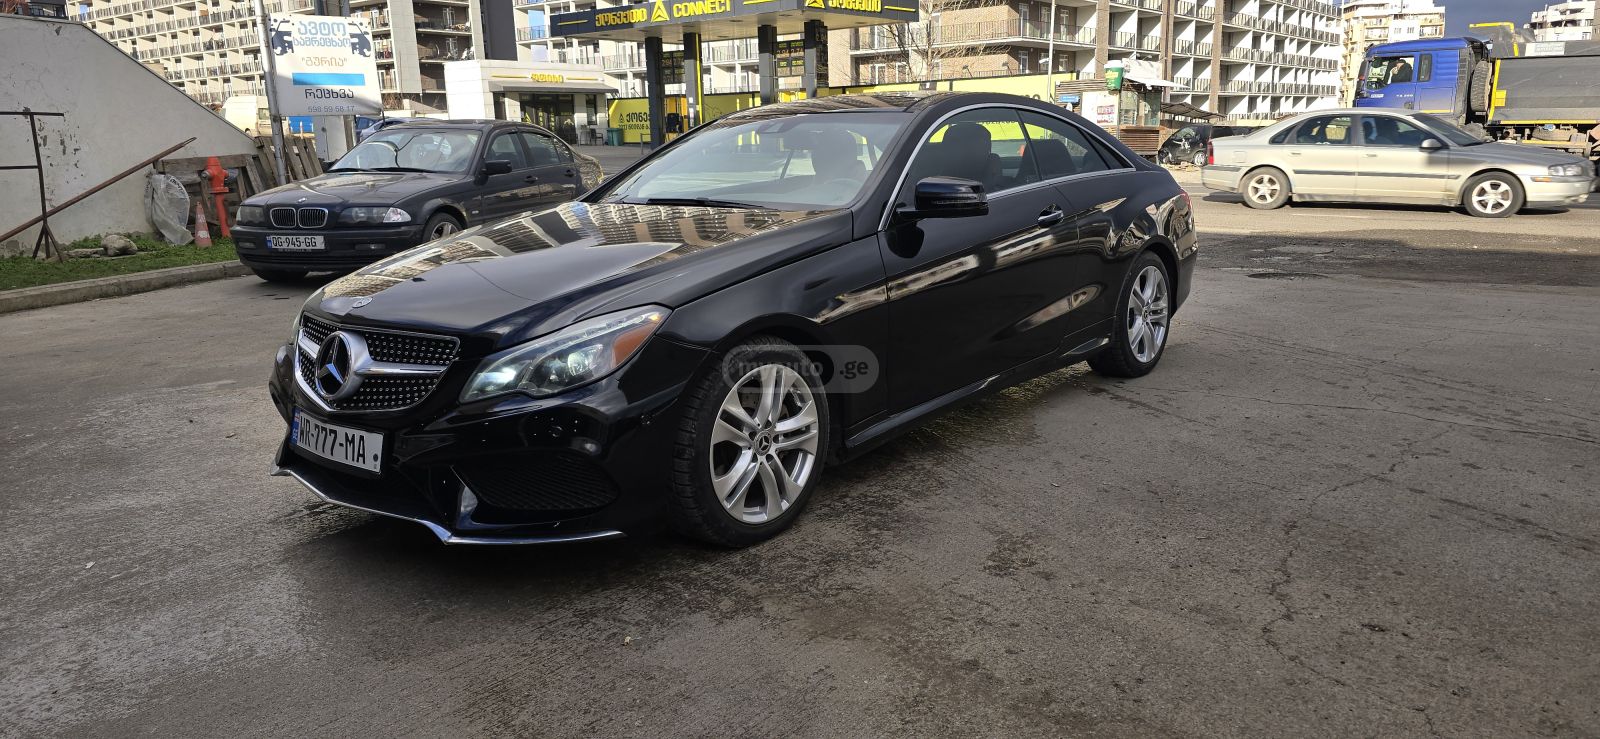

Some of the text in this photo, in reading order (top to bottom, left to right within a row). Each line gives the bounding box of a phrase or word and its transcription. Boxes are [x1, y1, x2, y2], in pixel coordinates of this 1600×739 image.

[673, 0, 731, 18] CONNECT
[297, 21, 347, 37] ავტო
[304, 88, 354, 99] რეცხვა
[308, 105, 322, 113] 598
[299, 415, 366, 465] WR-777-MA
